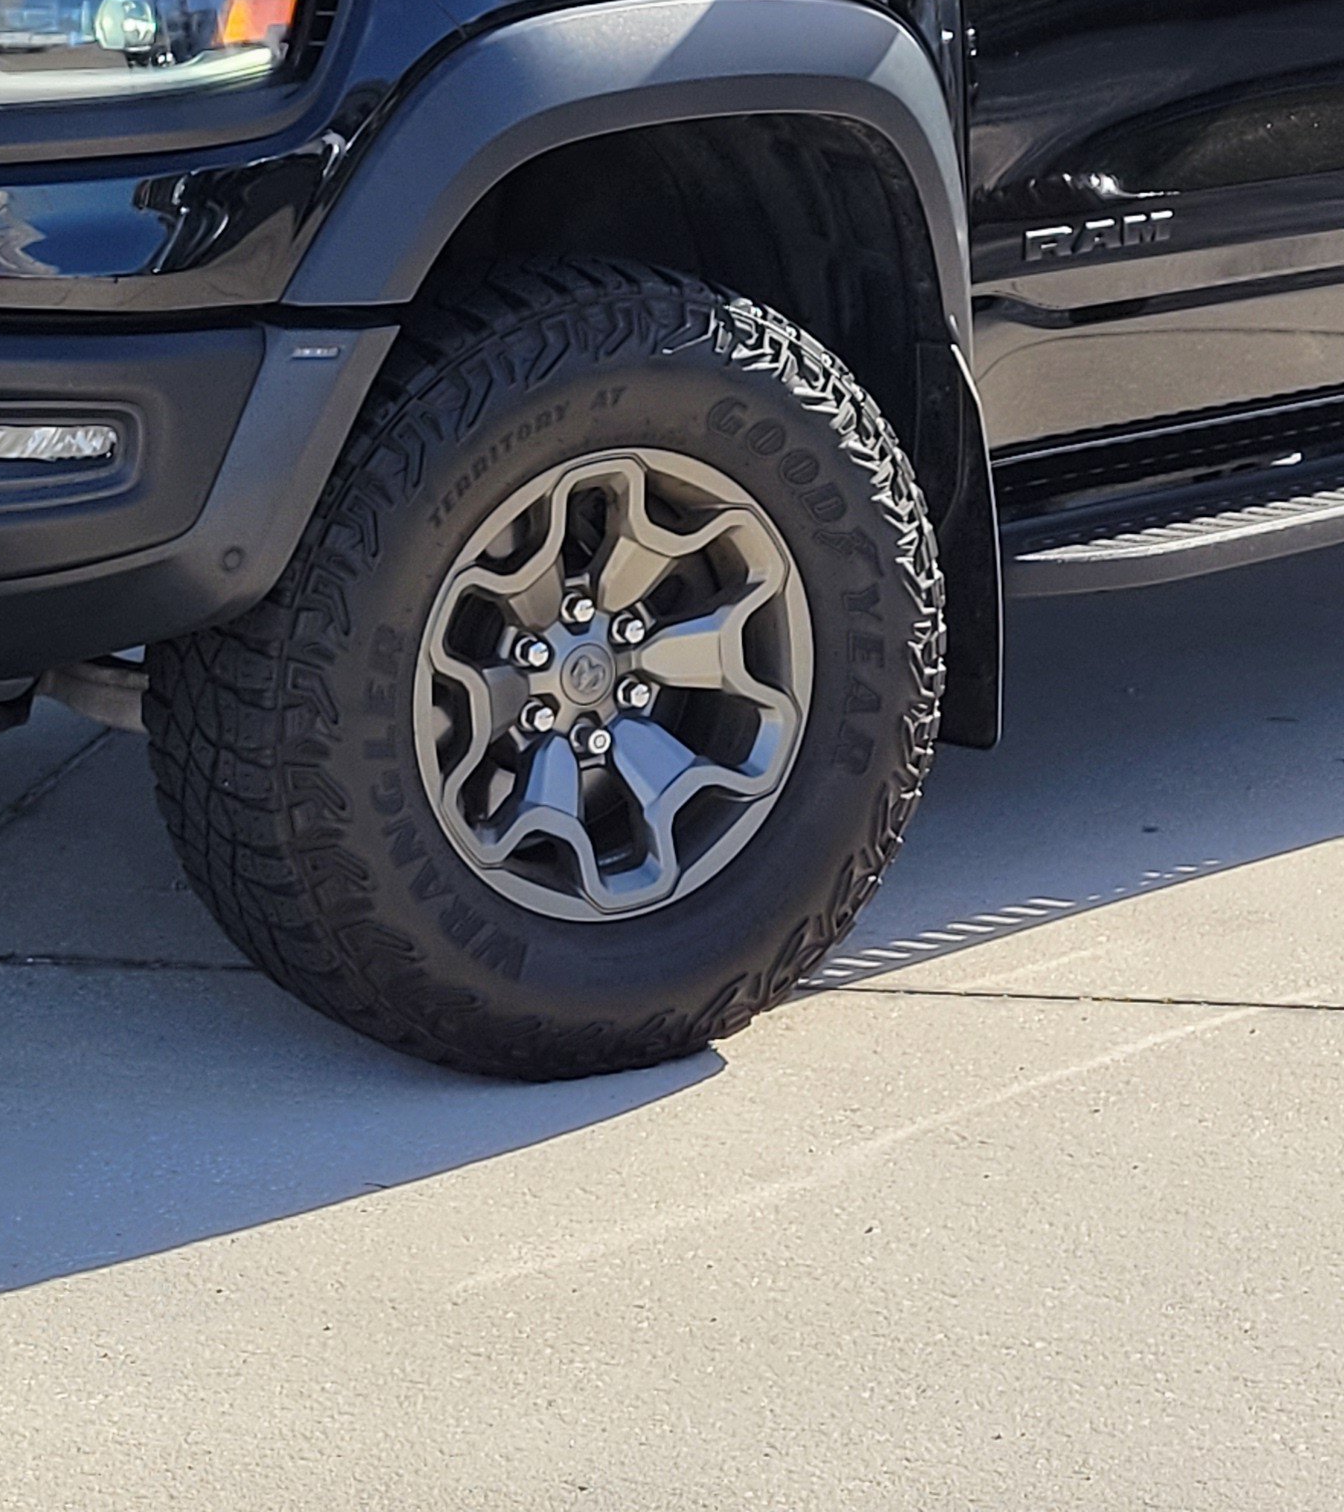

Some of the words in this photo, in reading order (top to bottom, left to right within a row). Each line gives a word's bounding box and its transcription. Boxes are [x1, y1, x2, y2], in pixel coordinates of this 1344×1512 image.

[1023, 209, 1175, 262] RAM
[429, 399, 570, 528] TERRITORY
[590, 385, 627, 410] AT
[362, 624, 529, 981] WRANGLER
